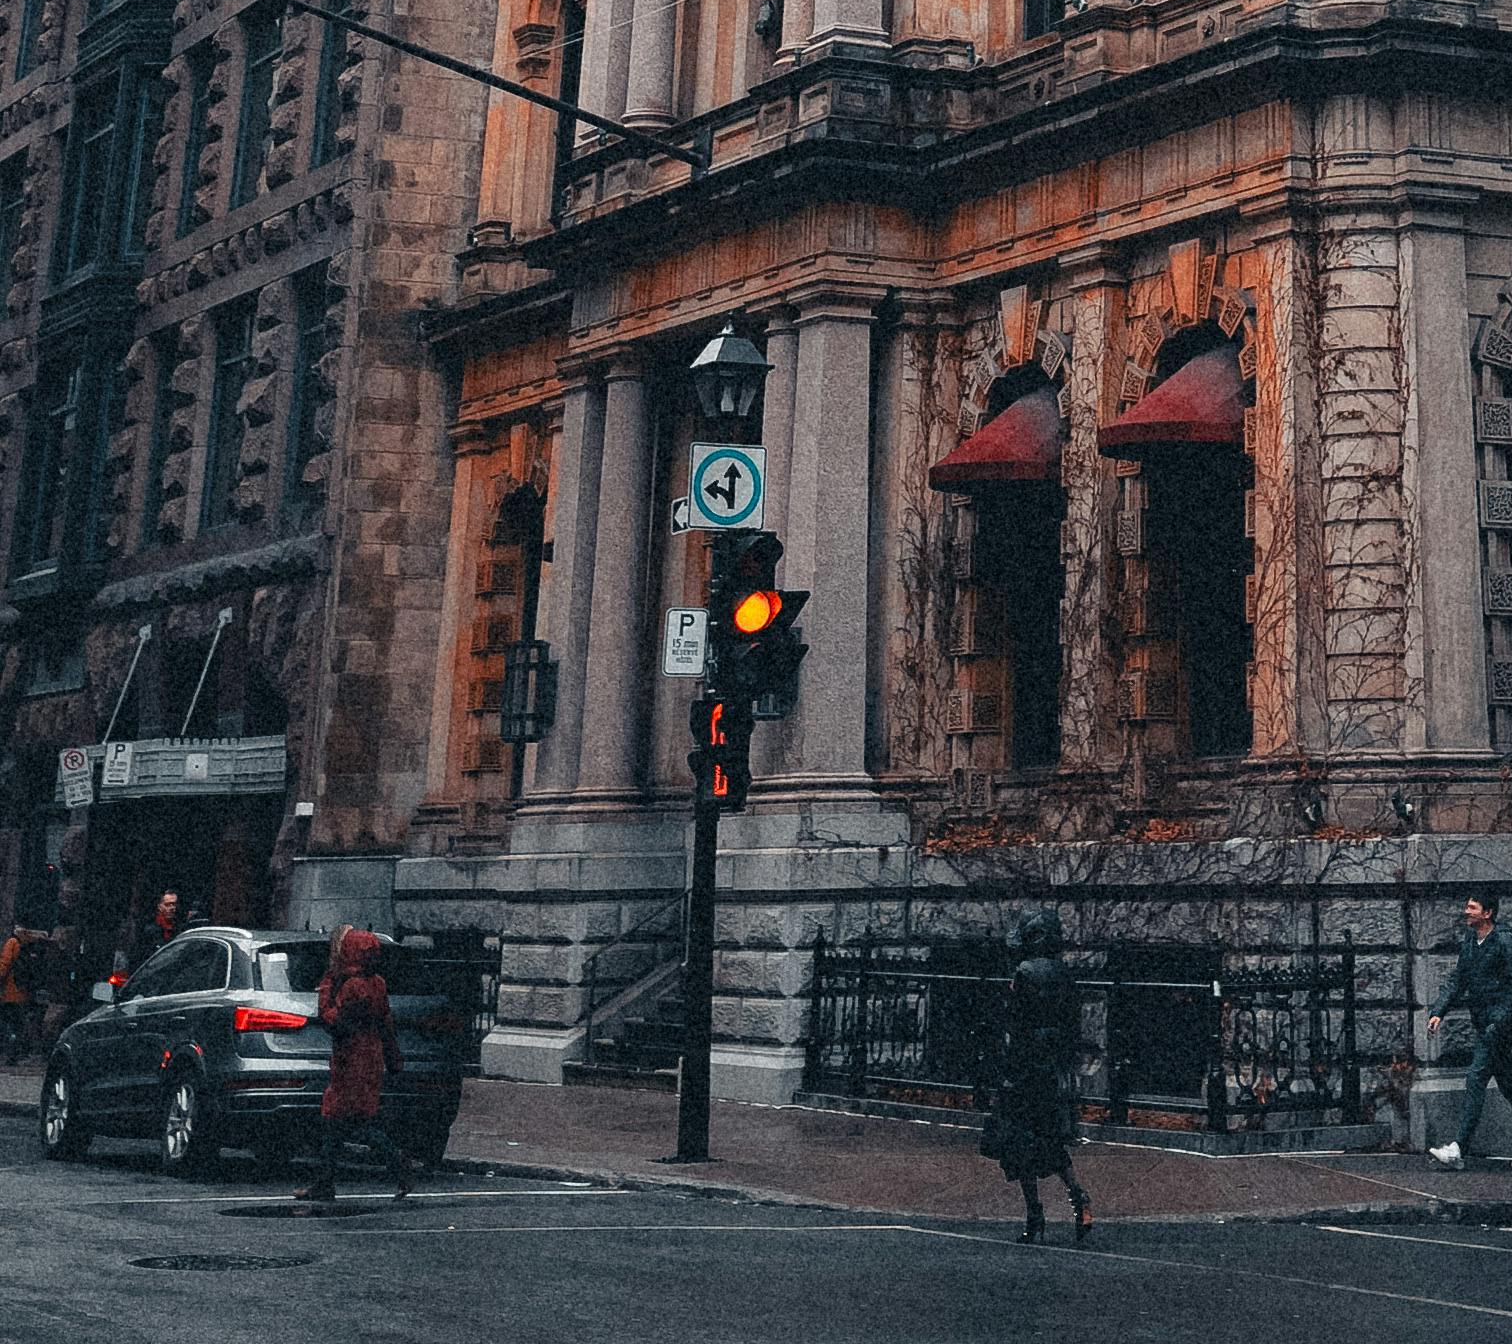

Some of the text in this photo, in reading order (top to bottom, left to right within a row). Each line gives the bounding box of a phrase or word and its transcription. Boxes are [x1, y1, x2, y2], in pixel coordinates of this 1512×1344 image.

[679, 613, 695, 637] P
[672, 638, 682, 648] 15
[114, 743, 126, 760] P
